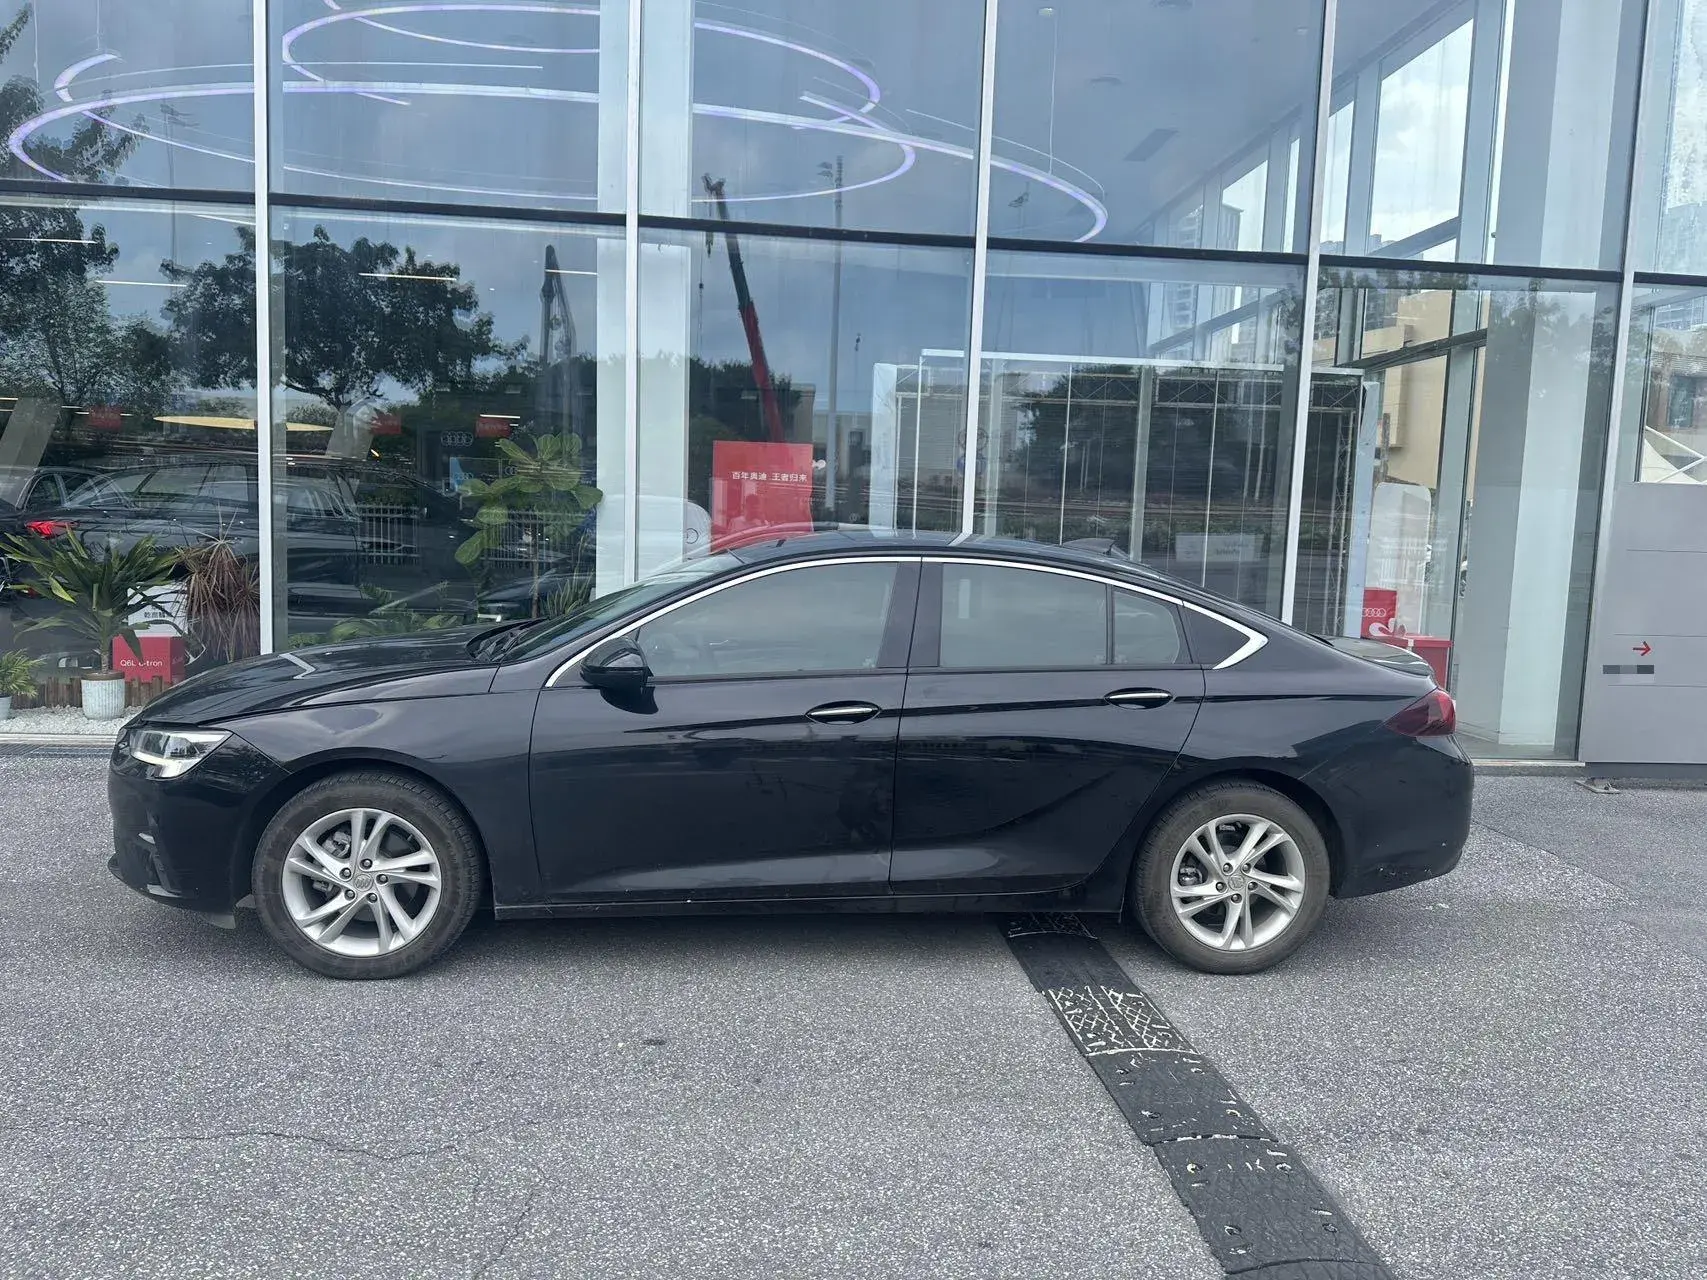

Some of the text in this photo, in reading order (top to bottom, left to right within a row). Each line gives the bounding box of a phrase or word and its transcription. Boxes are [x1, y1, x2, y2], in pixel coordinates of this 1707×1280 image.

[732, 471, 807, 482] 百年奥迪 王者归来
